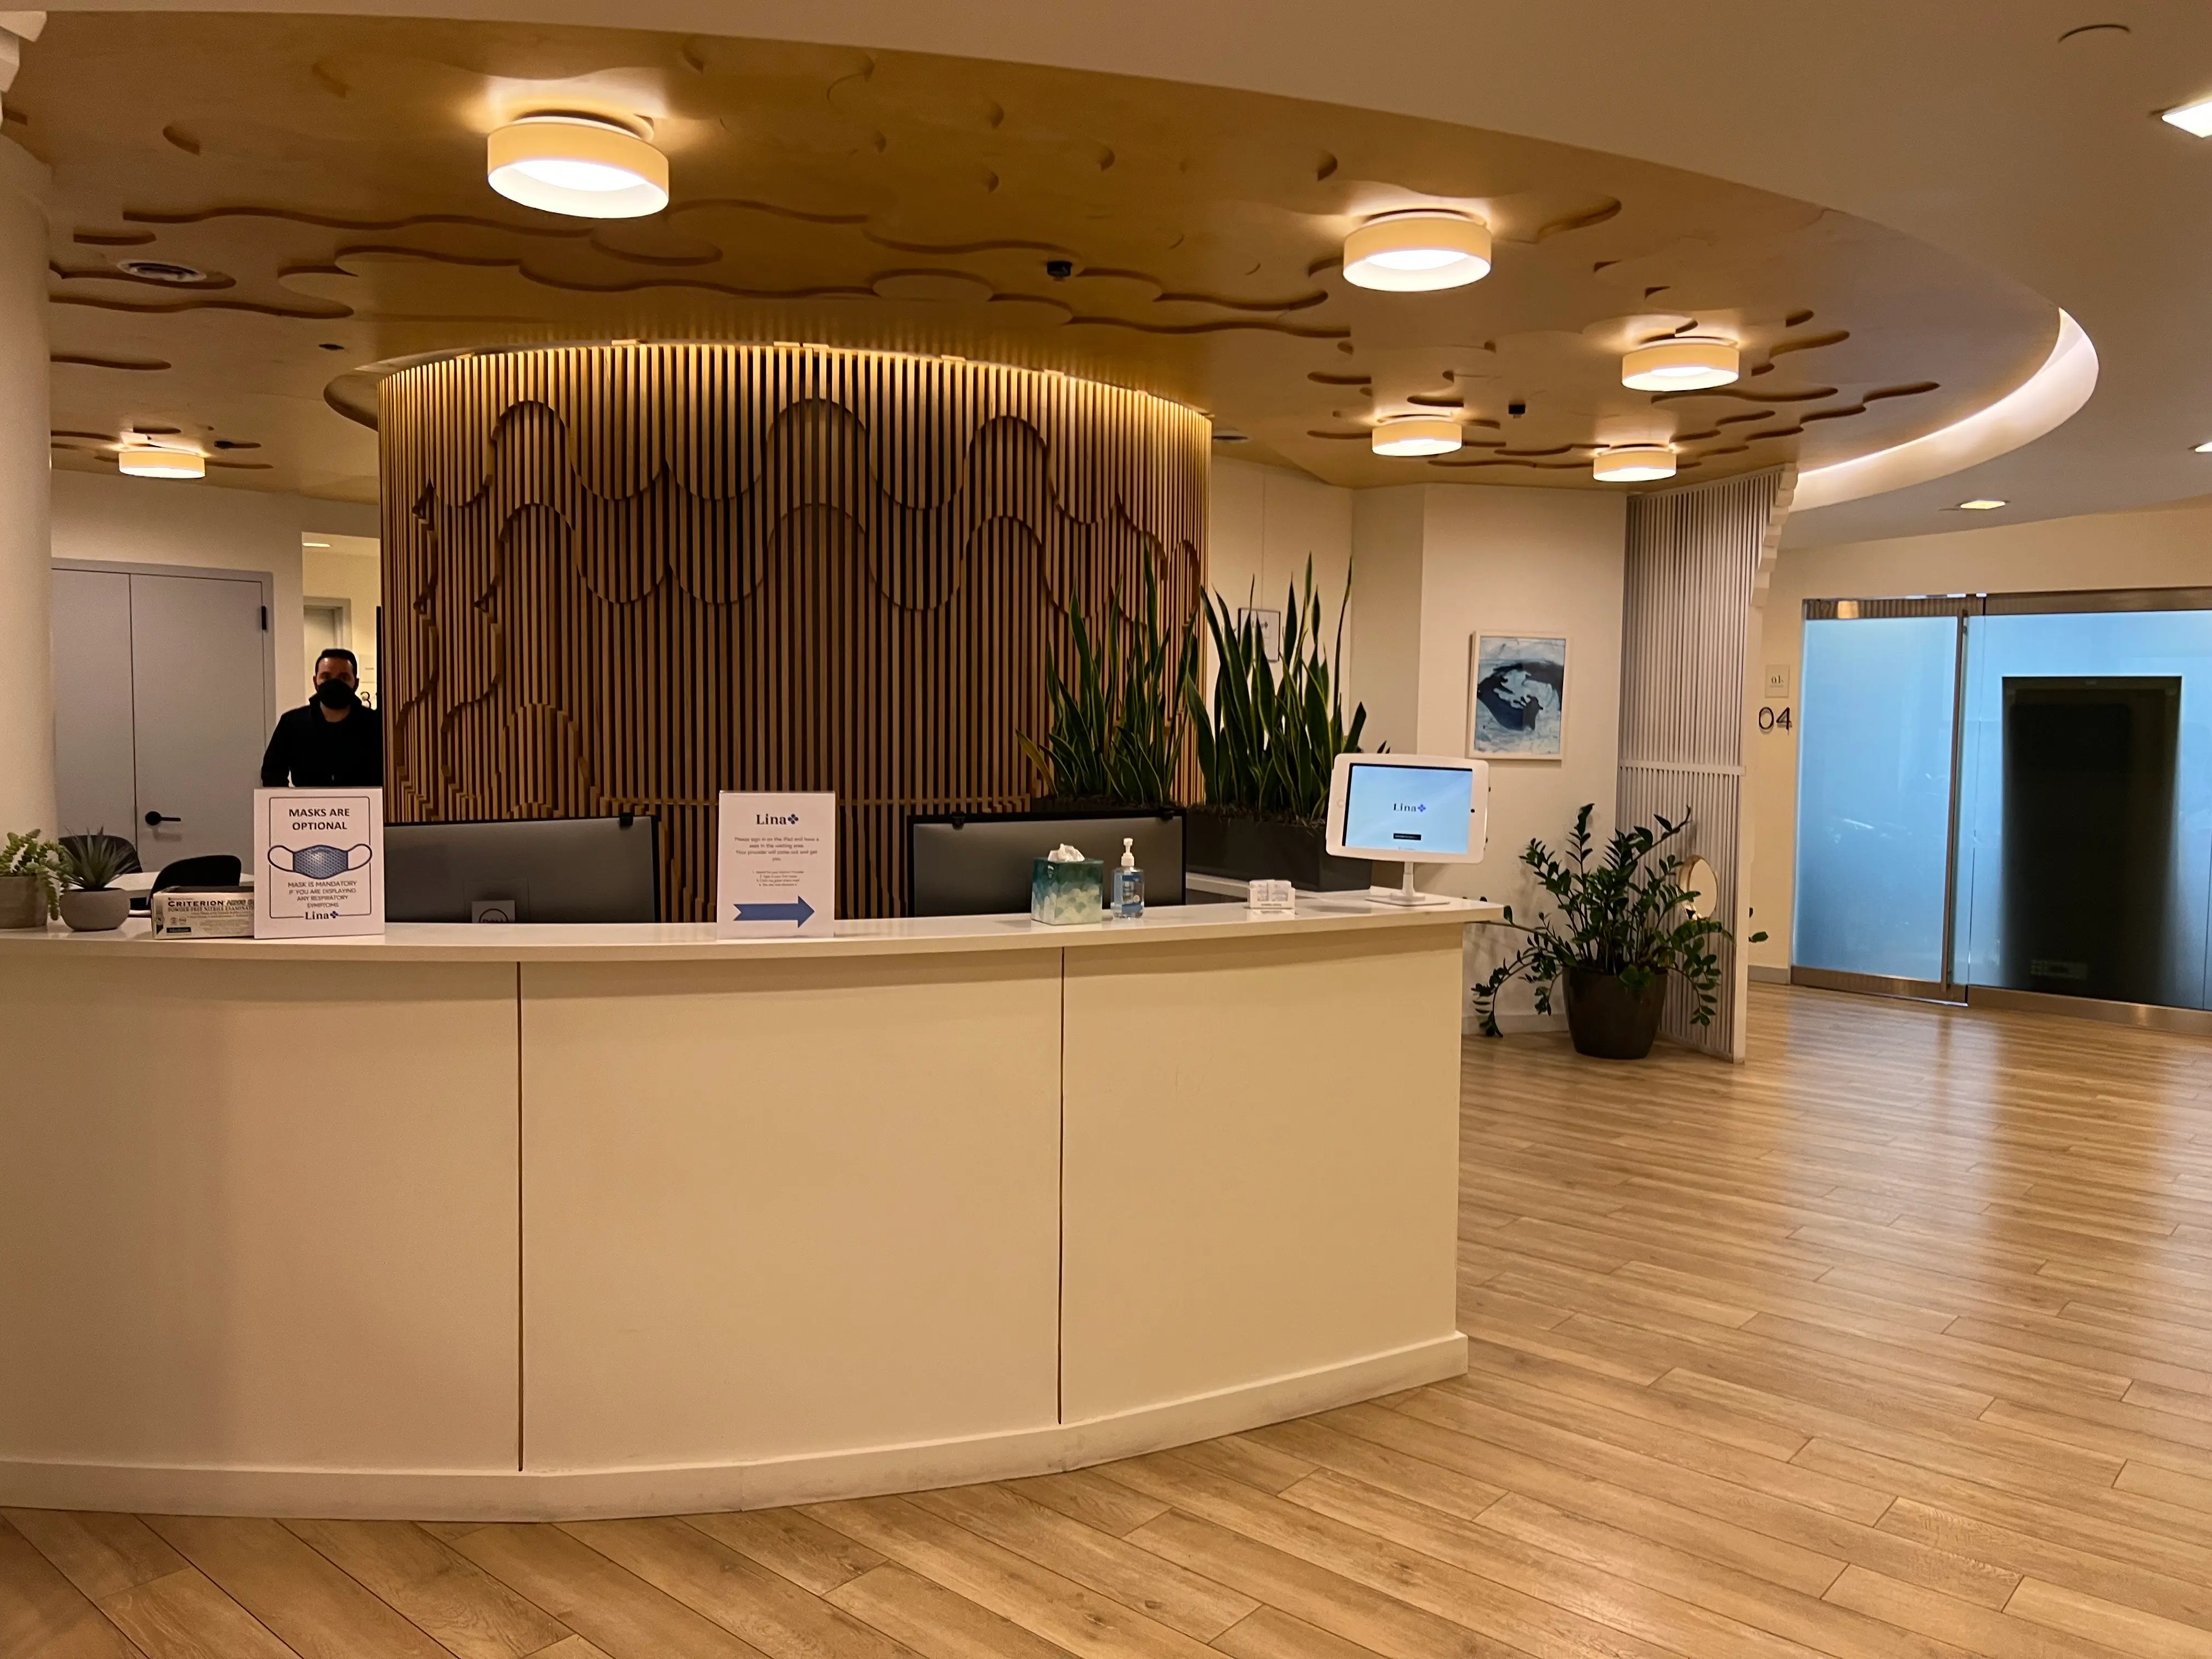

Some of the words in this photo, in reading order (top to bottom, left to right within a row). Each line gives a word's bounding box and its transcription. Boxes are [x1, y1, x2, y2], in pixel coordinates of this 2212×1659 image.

[1759, 707, 1792, 730] 04
[1393, 803, 1417, 811] Lina
[756, 813, 786, 825] Lina
[292, 822, 347, 831] OPTIONAL
[305, 911, 329, 919] Lina
